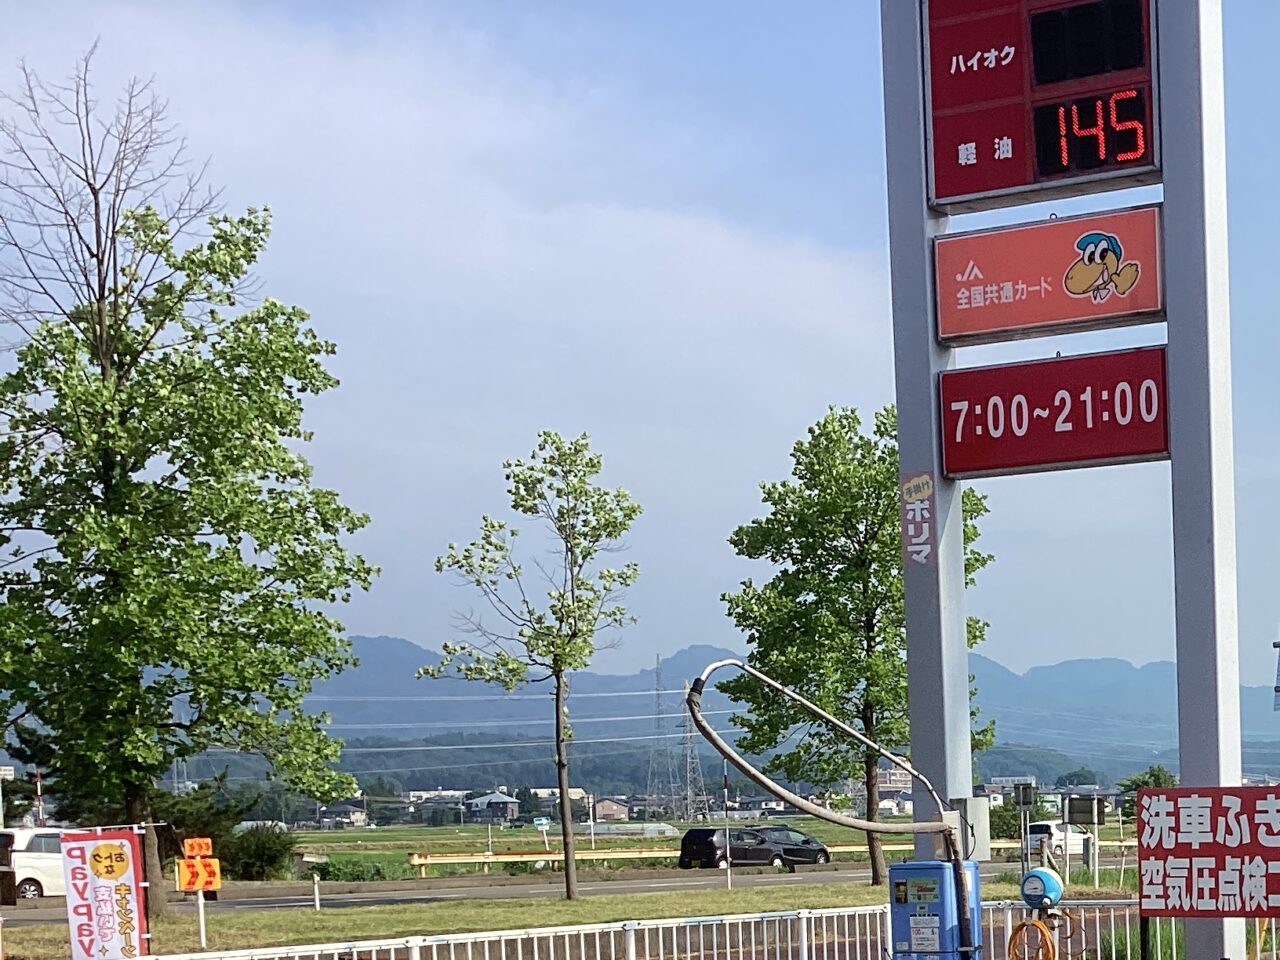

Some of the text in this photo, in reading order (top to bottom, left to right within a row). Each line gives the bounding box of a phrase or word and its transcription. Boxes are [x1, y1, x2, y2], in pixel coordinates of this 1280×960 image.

[949, 45, 1016, 74] ハイオク
[1058, 90, 1144, 166] 145
[957, 136, 1013, 166] 軽油
[956, 259, 984, 282] JA
[956, 275, 1053, 309] 全国共通カード
